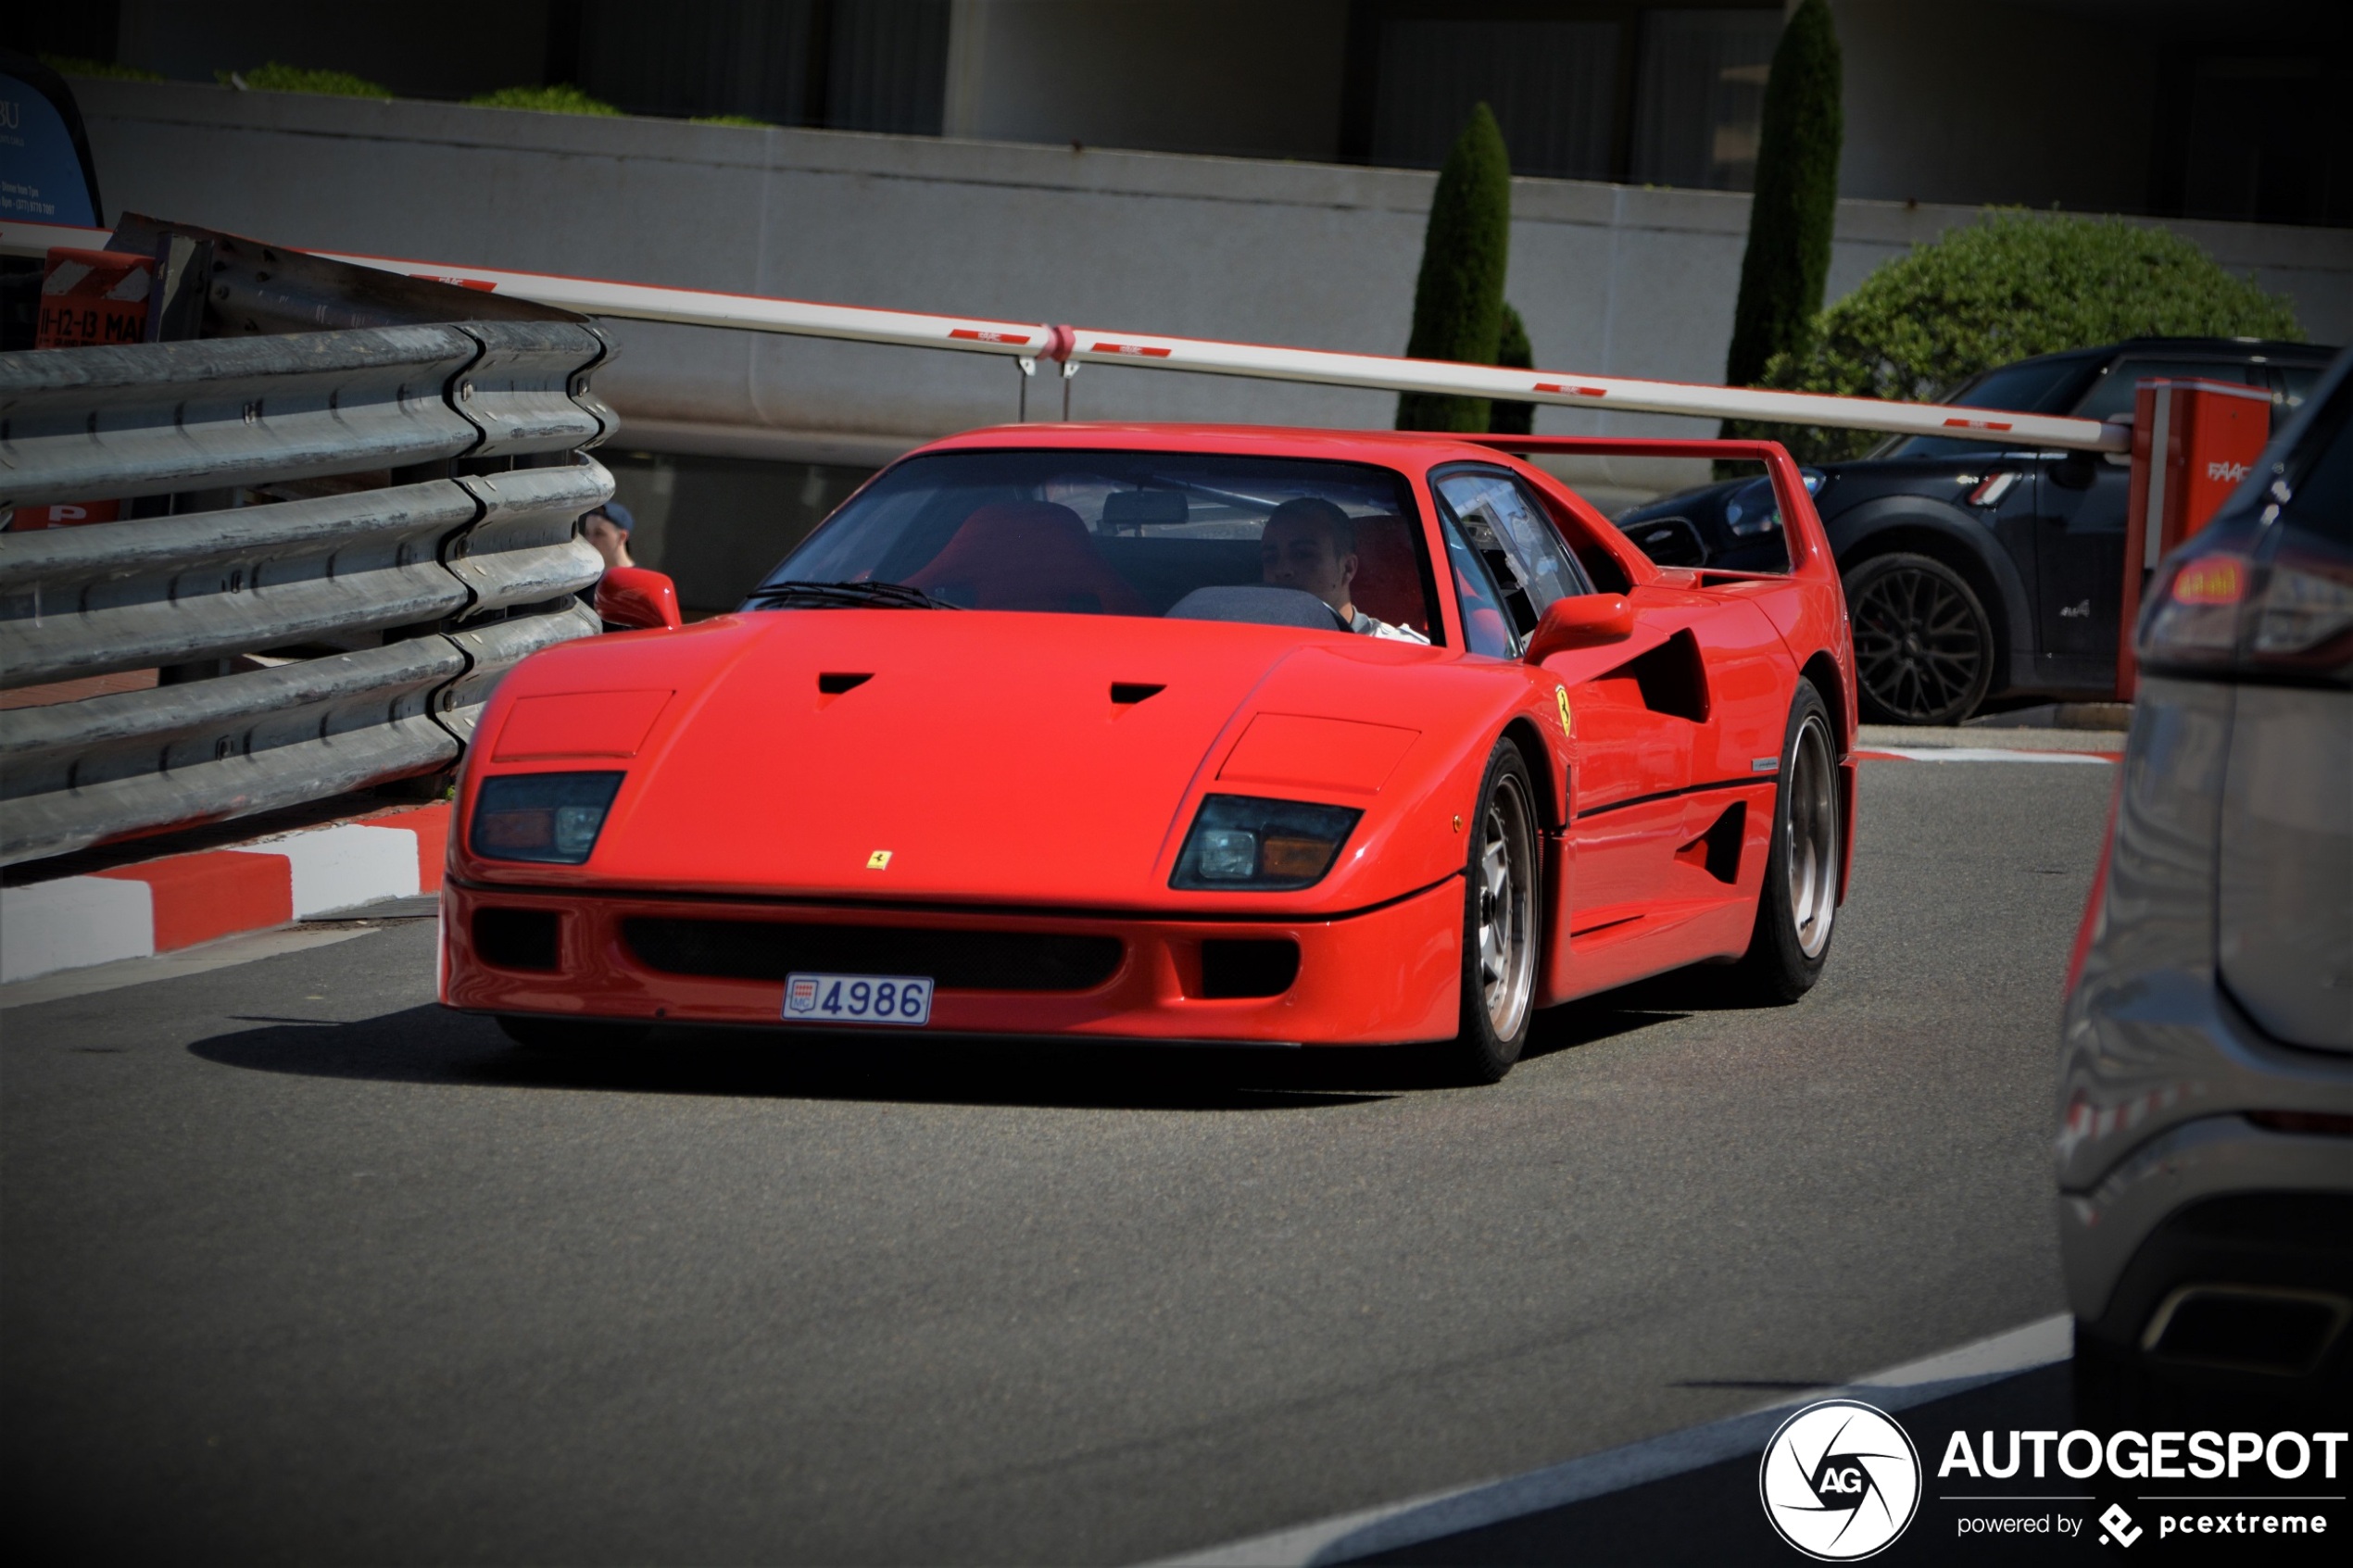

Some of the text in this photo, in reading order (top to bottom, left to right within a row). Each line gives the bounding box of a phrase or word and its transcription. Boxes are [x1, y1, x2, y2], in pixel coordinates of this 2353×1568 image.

[41, 308, 97, 339] 11-12-13
[794, 980, 924, 1018] MC 4986
